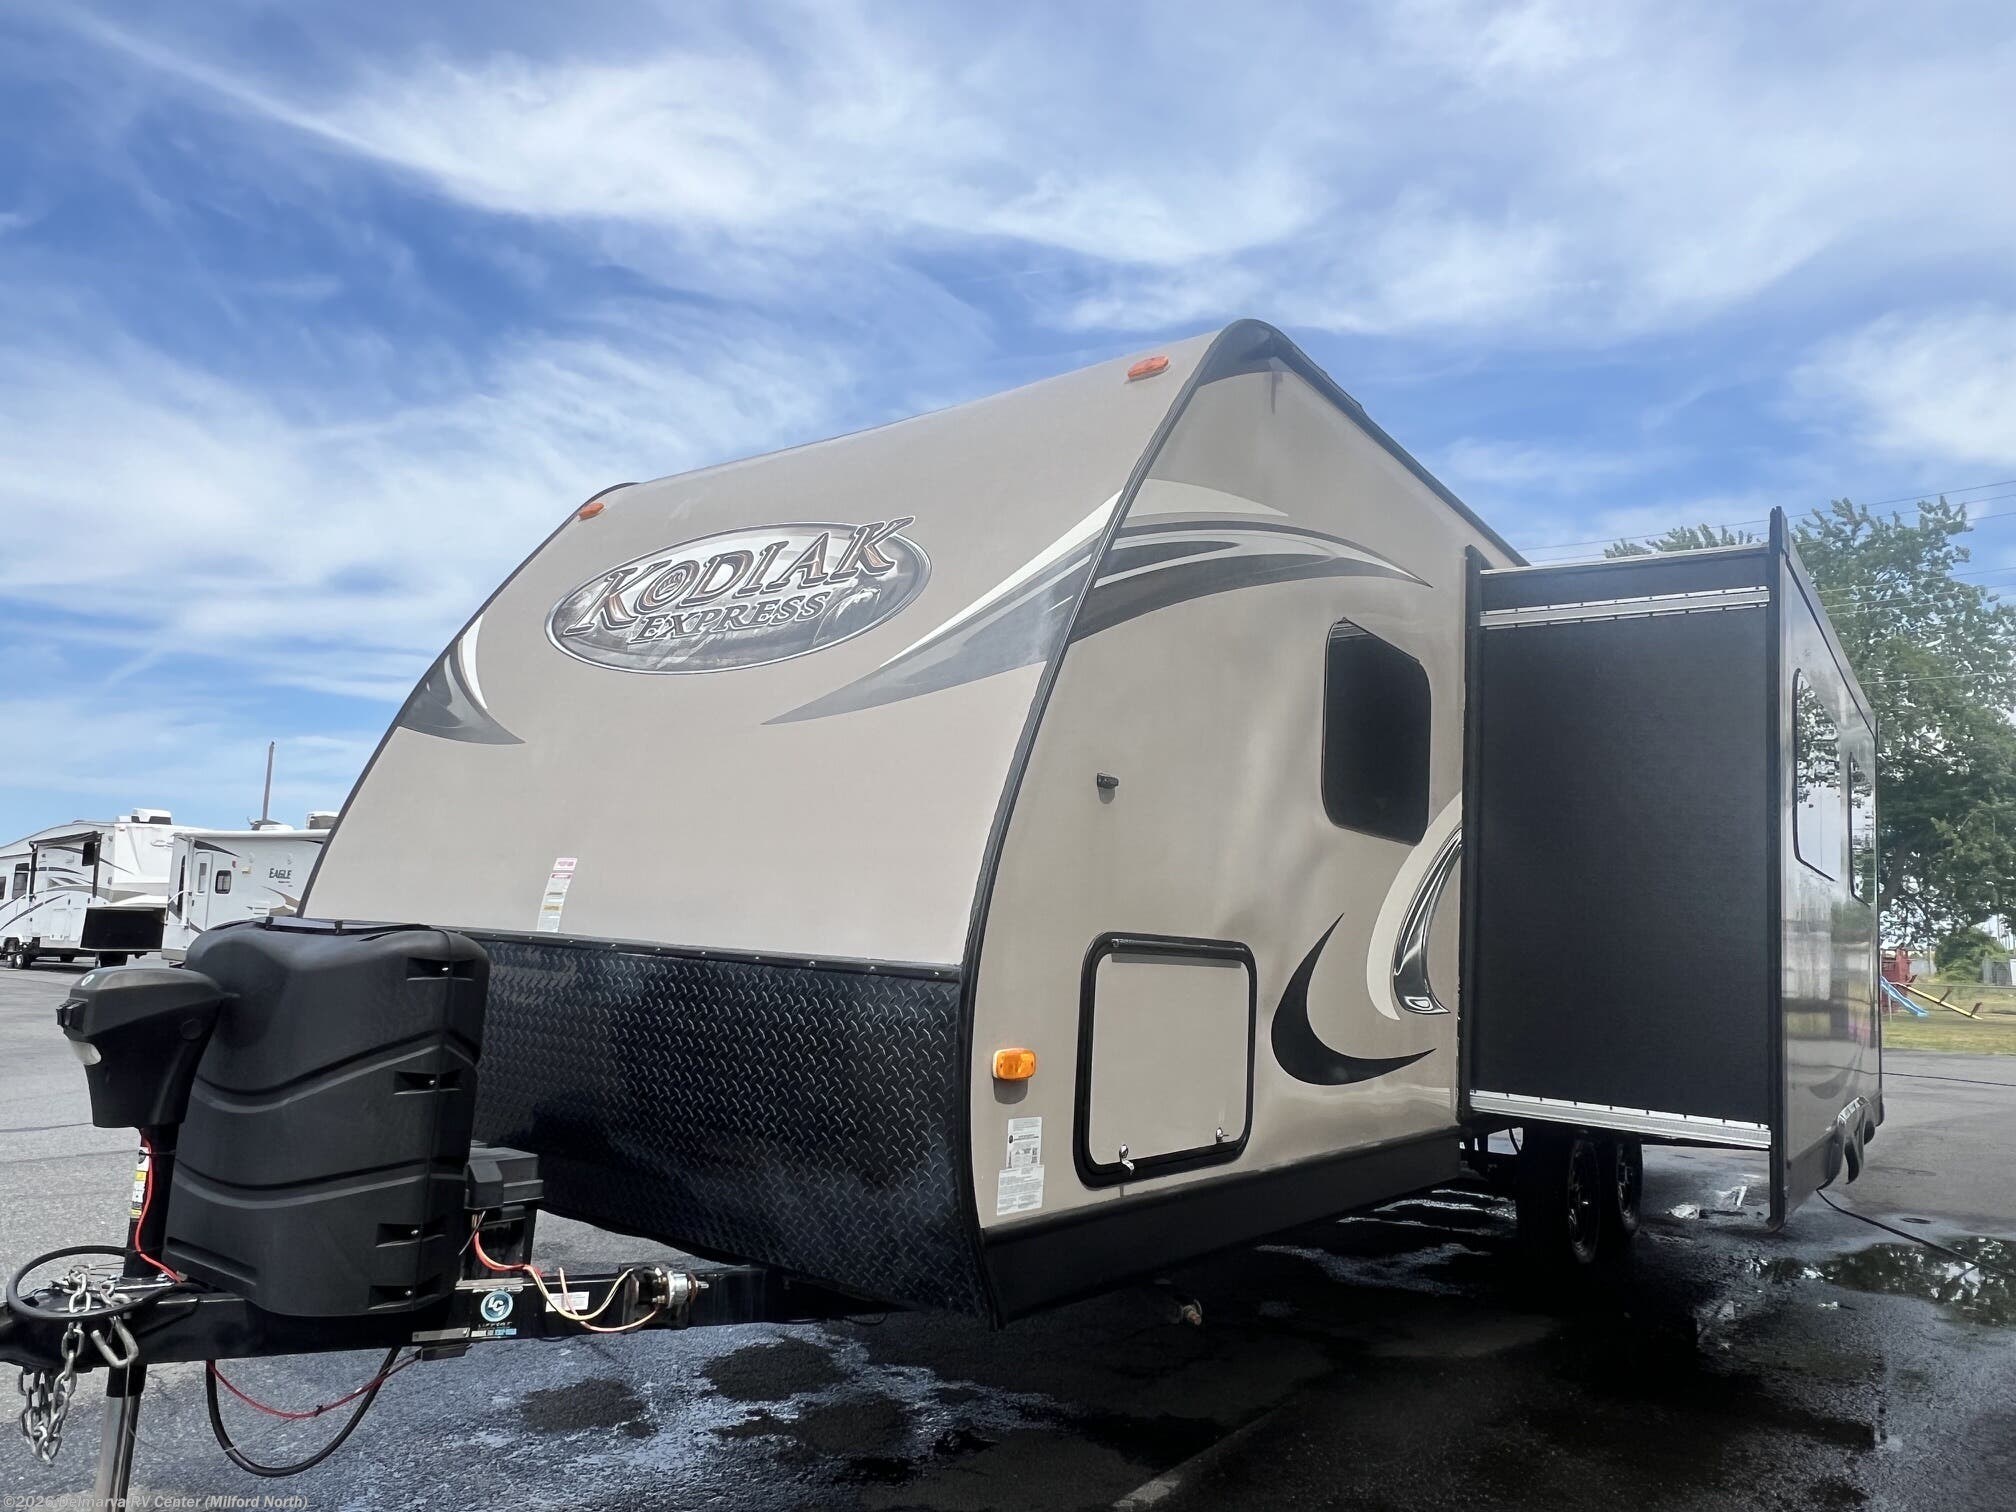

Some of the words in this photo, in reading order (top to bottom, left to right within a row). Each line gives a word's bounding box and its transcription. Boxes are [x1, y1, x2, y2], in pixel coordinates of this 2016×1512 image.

[563, 516, 915, 636] KODIAK
[628, 590, 832, 644] EXPRESS
[269, 867, 292, 880] EAGLE
